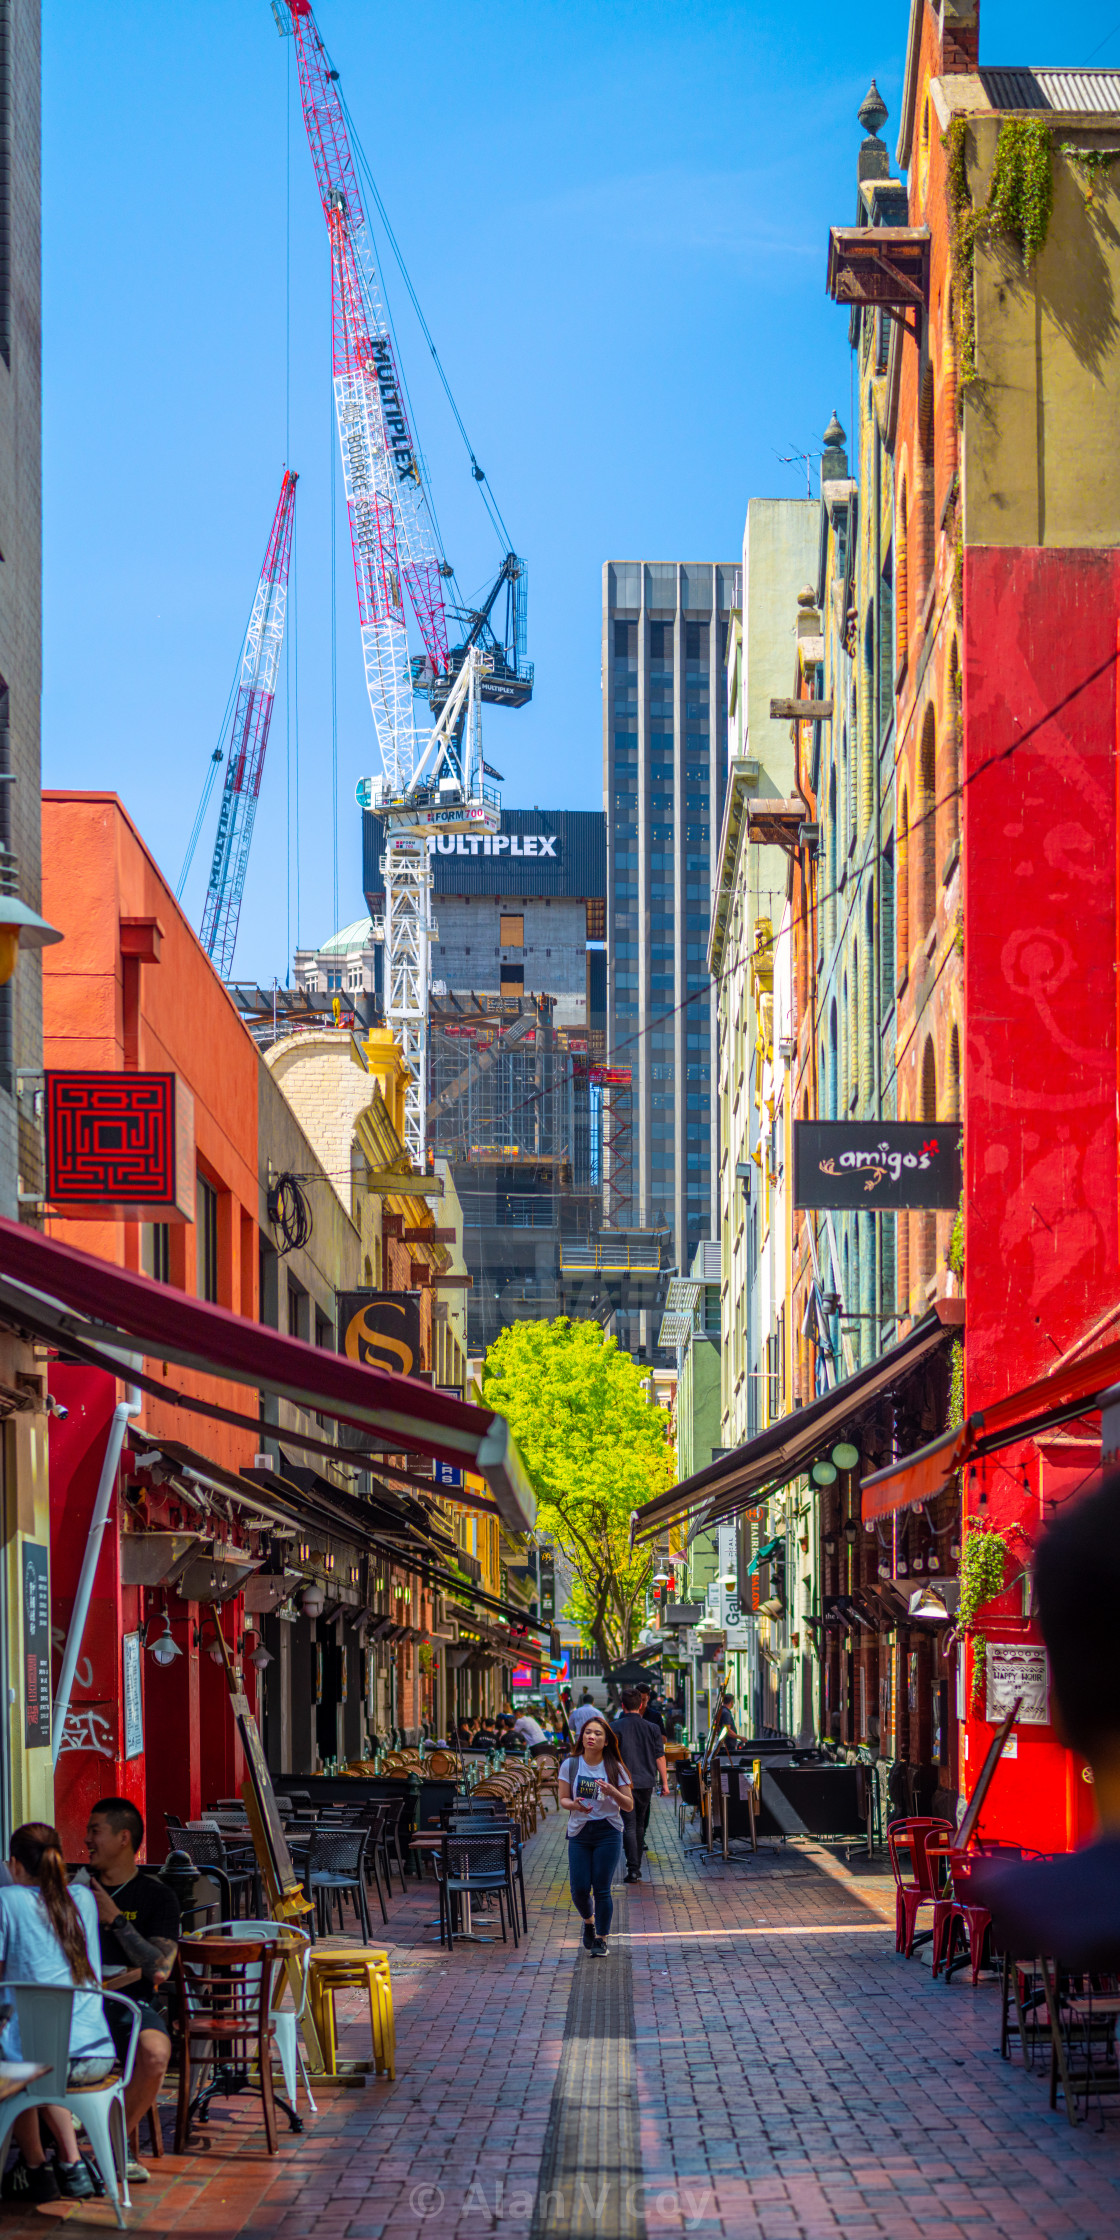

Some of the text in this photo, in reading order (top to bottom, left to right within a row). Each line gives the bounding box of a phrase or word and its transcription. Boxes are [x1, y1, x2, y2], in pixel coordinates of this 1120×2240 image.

[370, 340, 416, 482] MULTIPLEX
[348, 434, 369, 495] BOURKE
[355, 500, 375, 556] STREET
[481, 683, 514, 695] MULTIPLEX
[435, 808, 483, 822] FORM 700
[839, 1141, 931, 1181] amigos
[751, 1575, 760, 1611] SALONS
